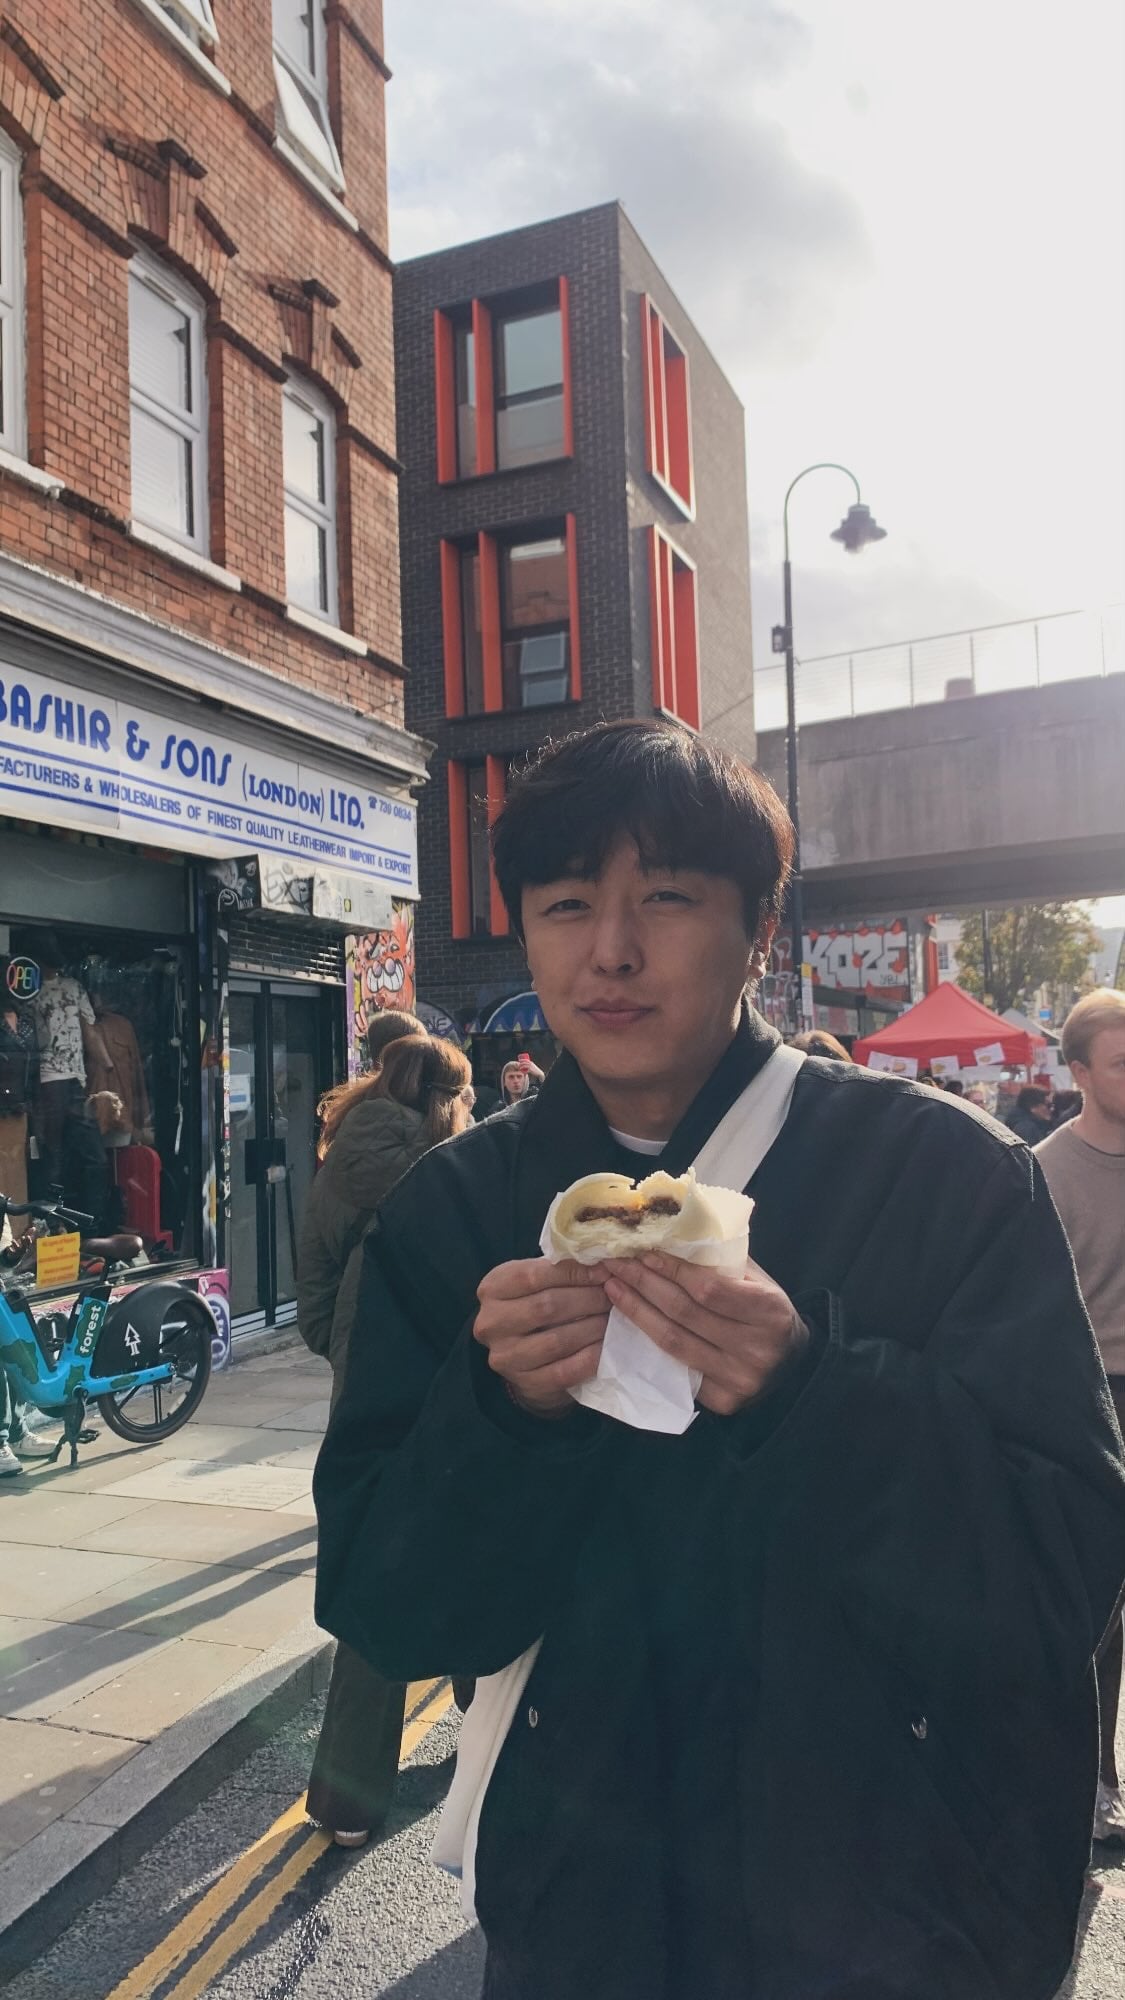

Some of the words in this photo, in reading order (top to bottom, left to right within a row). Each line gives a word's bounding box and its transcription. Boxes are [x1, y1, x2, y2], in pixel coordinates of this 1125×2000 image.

[126, 720, 149, 761] &
[161, 734, 232, 787] SONS
[242, 762, 325, 822] (LONDON)
[330, 788, 365, 830] LTD.
[84, 778, 93, 793] &
[99, 780, 181, 816] WHOLESALERS
[187, 804, 201, 821] OF
[207, 810, 242, 832] FINEST
[246, 820, 284, 842] QUALITY
[288, 830, 346, 858] LEATHERWEAR
[349, 847, 375, 865] IMPORT
[378, 856, 383, 868] &
[384, 857, 411, 876] EXPORT
[6, 964, 41, 990] OPEN
[79, 1304, 102, 1354] forest
